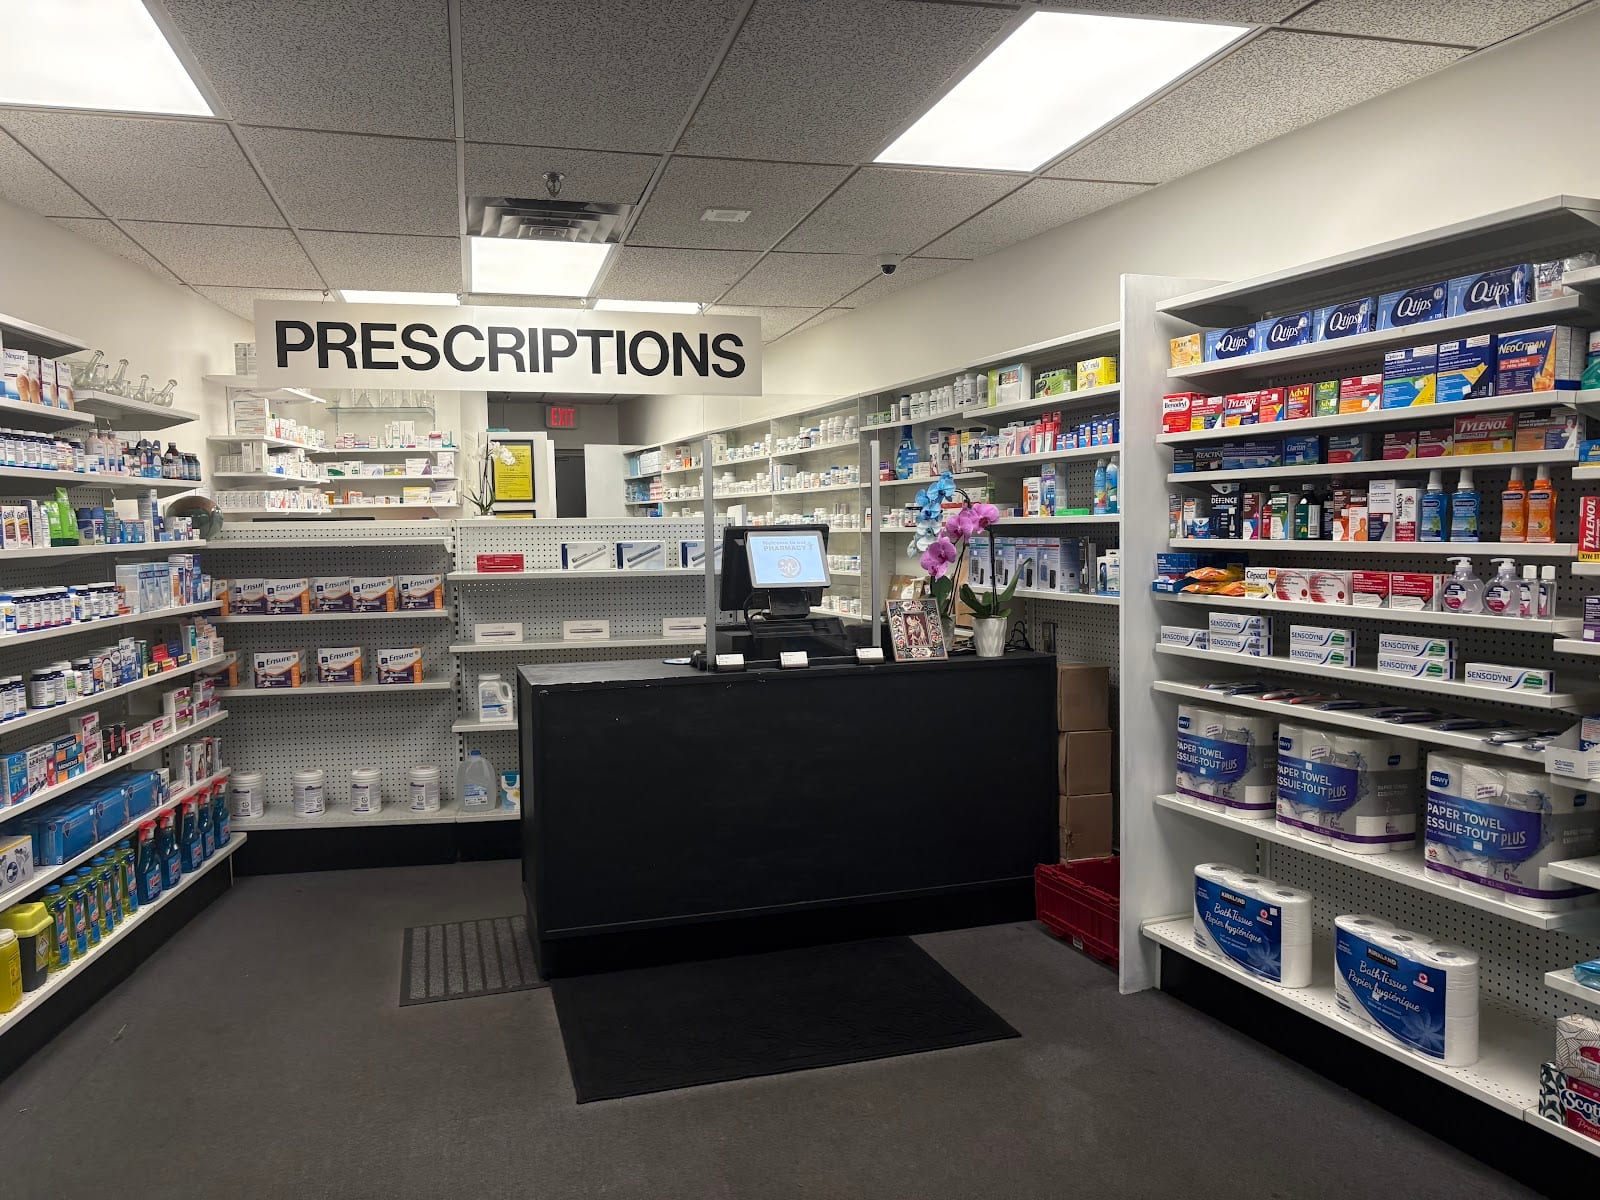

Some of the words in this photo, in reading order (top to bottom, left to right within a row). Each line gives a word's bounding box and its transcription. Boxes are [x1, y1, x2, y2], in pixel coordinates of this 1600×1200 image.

[275, 320, 746, 378] PRESCRIPTIONS
[1289, 386, 1310, 398] Advil
[551, 407, 575, 427] EXIT
[1460, 420, 1508, 433] TYLENOL
[1583, 499, 1596, 550] TYLENOL
[243, 583, 263, 591] Ensur
[276, 582, 302, 592] Ensure
[361, 579, 386, 590] Ensure
[410, 578, 434, 587] Ensure
[1210, 620, 1241, 629] SENSODYNE
[1162, 632, 1189, 642] SENSODYNE
[1291, 631, 1323, 641] SENSODYNE
[1211, 638, 1241, 648] SENSODYNE
[1380, 640, 1420, 651] SENSODYNE
[266, 655, 291, 665] Ensure
[329, 650, 354, 660] Ensure
[389, 652, 414, 662] Ensure
[1291, 649, 1323, 660] SENSODYNE
[1379, 660, 1418, 671] SENSODYNE
[1467, 670, 1513, 683] SENSODYNE
[1198, 746, 1224, 759] TOWEL
[1222, 759, 1237, 771] PLUS
[1301, 770, 1332, 786] TOWEL
[1431, 775, 1448, 785] savvy
[1328, 785, 1347, 798] PLUS
[1427, 803, 1460, 820] PAPER
[1463, 812, 1505, 831] TOWEL
[1427, 816, 1498, 842] ESSUIE-TOUT
[1500, 831, 1526, 846] PLUS
[1205, 911, 1224, 928] Papier
[1214, 902, 1232, 918] Bath
[1232, 909, 1253, 927] Tissue
[1360, 960, 1382, 979] Bath
[1381, 970, 1408, 992] Tissue
[1348, 969, 1373, 991] Papier
[1373, 982, 1420, 1013] hygiénique
